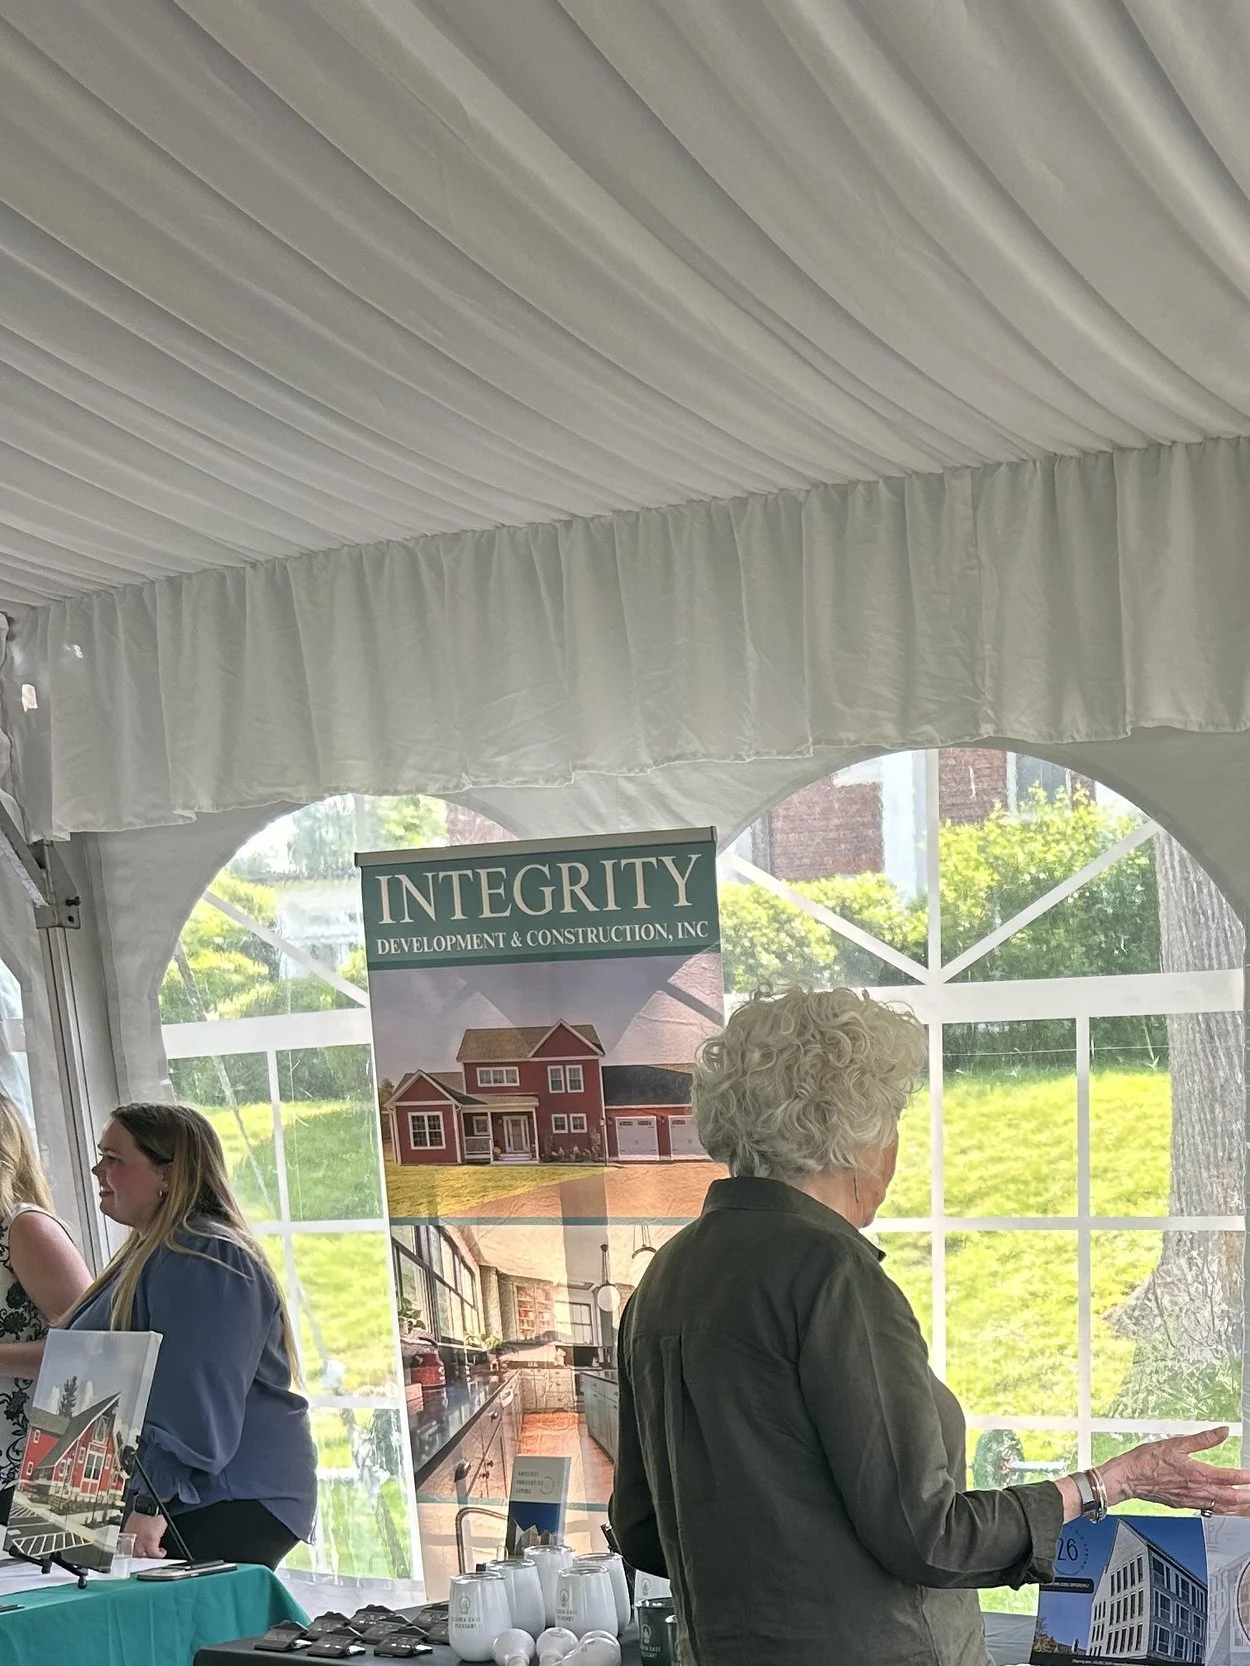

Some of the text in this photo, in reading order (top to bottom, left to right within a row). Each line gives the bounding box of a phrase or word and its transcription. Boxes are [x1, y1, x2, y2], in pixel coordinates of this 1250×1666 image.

[374, 853, 702, 925] INTEGRITY
[377, 920, 709, 955] DEVELOPMENT & CONSTRUCTION, INC
